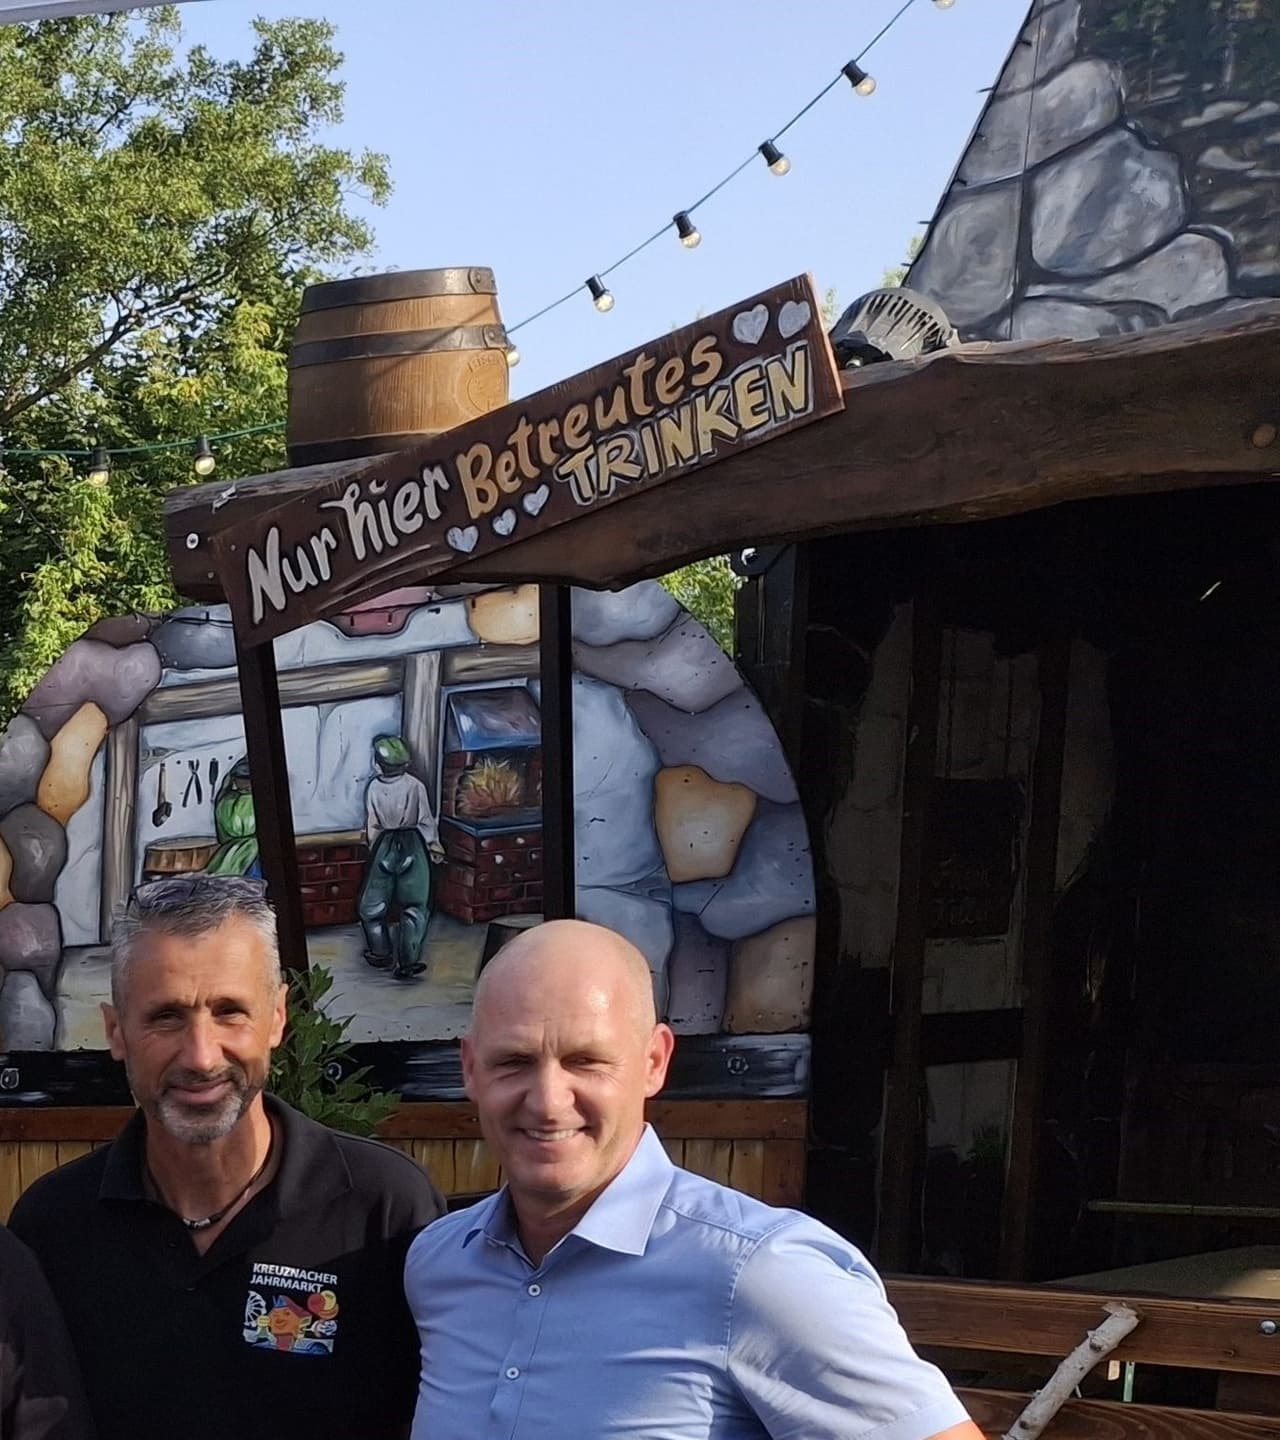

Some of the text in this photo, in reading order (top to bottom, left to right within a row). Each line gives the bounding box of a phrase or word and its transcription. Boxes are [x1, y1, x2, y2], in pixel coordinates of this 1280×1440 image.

[556, 341, 814, 504] TRINKEN
[247, 335, 724, 624] Nur hier Betreutes
[250, 1274, 324, 1293] JAHRMARKT
[253, 1263, 338, 1285] KREUZNACHER
